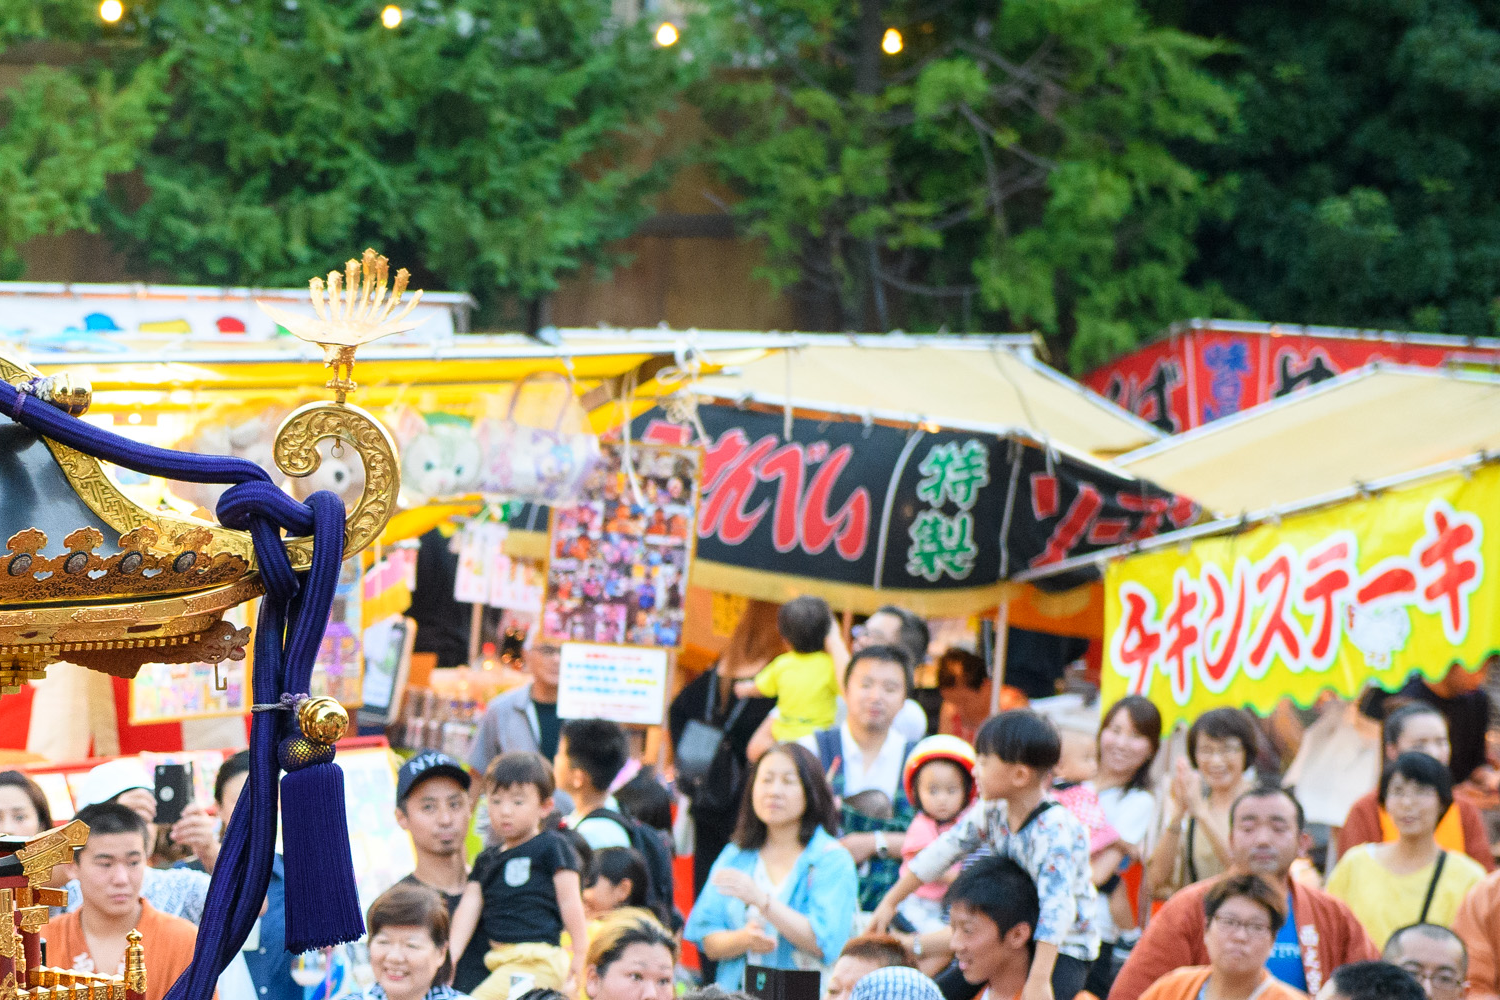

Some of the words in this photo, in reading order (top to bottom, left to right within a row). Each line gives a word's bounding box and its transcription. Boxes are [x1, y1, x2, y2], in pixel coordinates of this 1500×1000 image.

[905, 437, 990, 582] 特製
[1113, 503, 1482, 703] チキンステーキ
